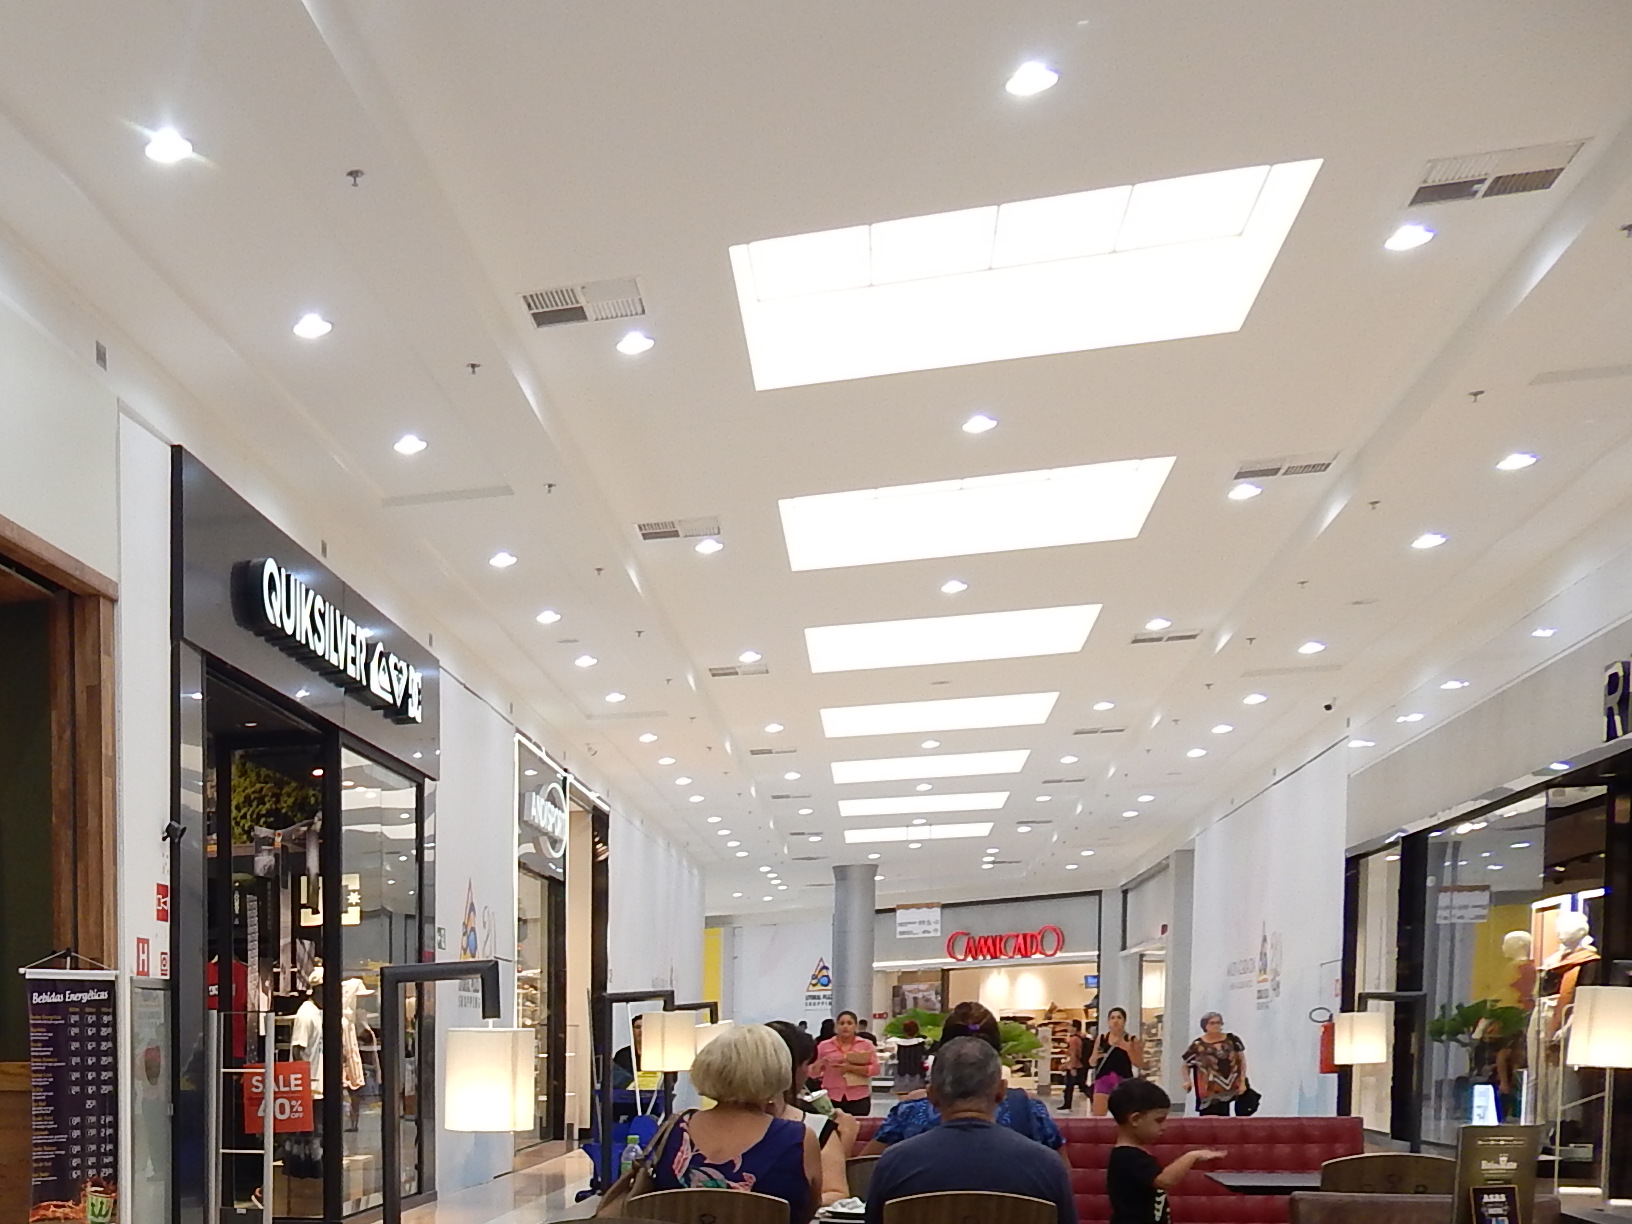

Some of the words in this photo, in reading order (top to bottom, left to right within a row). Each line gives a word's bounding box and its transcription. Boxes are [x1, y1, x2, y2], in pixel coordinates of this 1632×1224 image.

[263, 557, 367, 687] QUIKSILVER
[139, 942, 148, 972] H
[946, 925, 1065, 961] CAMICADO
[32, 991, 64, 1004] Bebidas
[65, 988, 109, 1003] Energéticas
